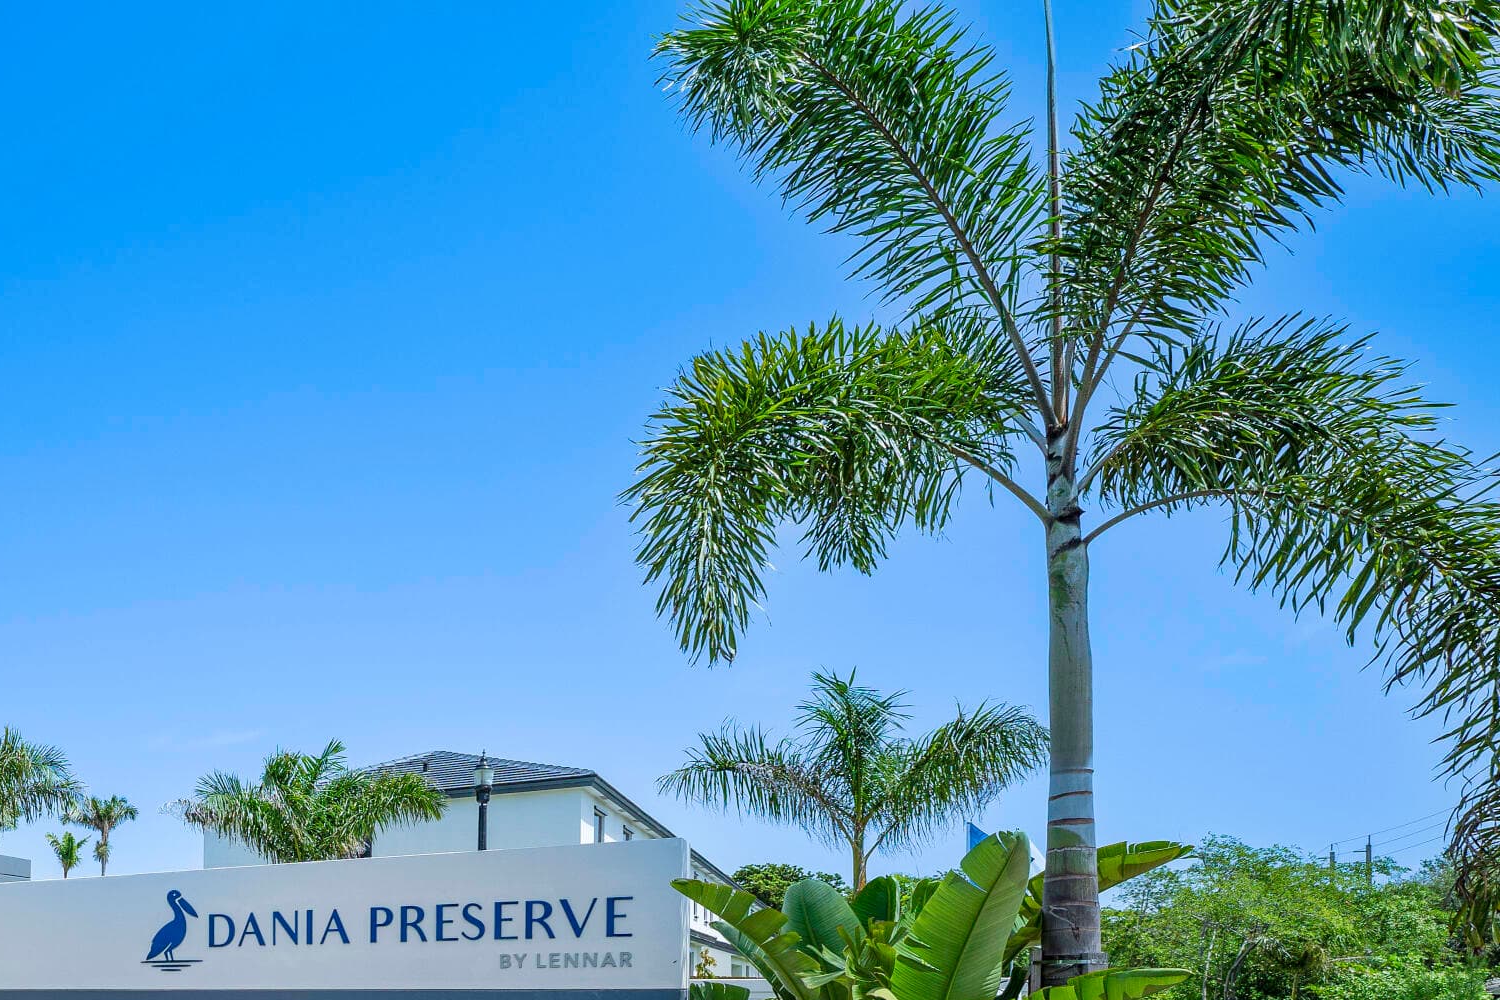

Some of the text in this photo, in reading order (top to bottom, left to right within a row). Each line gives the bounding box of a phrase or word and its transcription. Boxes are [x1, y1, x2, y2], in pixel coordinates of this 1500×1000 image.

[208, 896, 634, 948] DANIA PRESERVE
[499, 951, 633, 970] BY LENNAR
